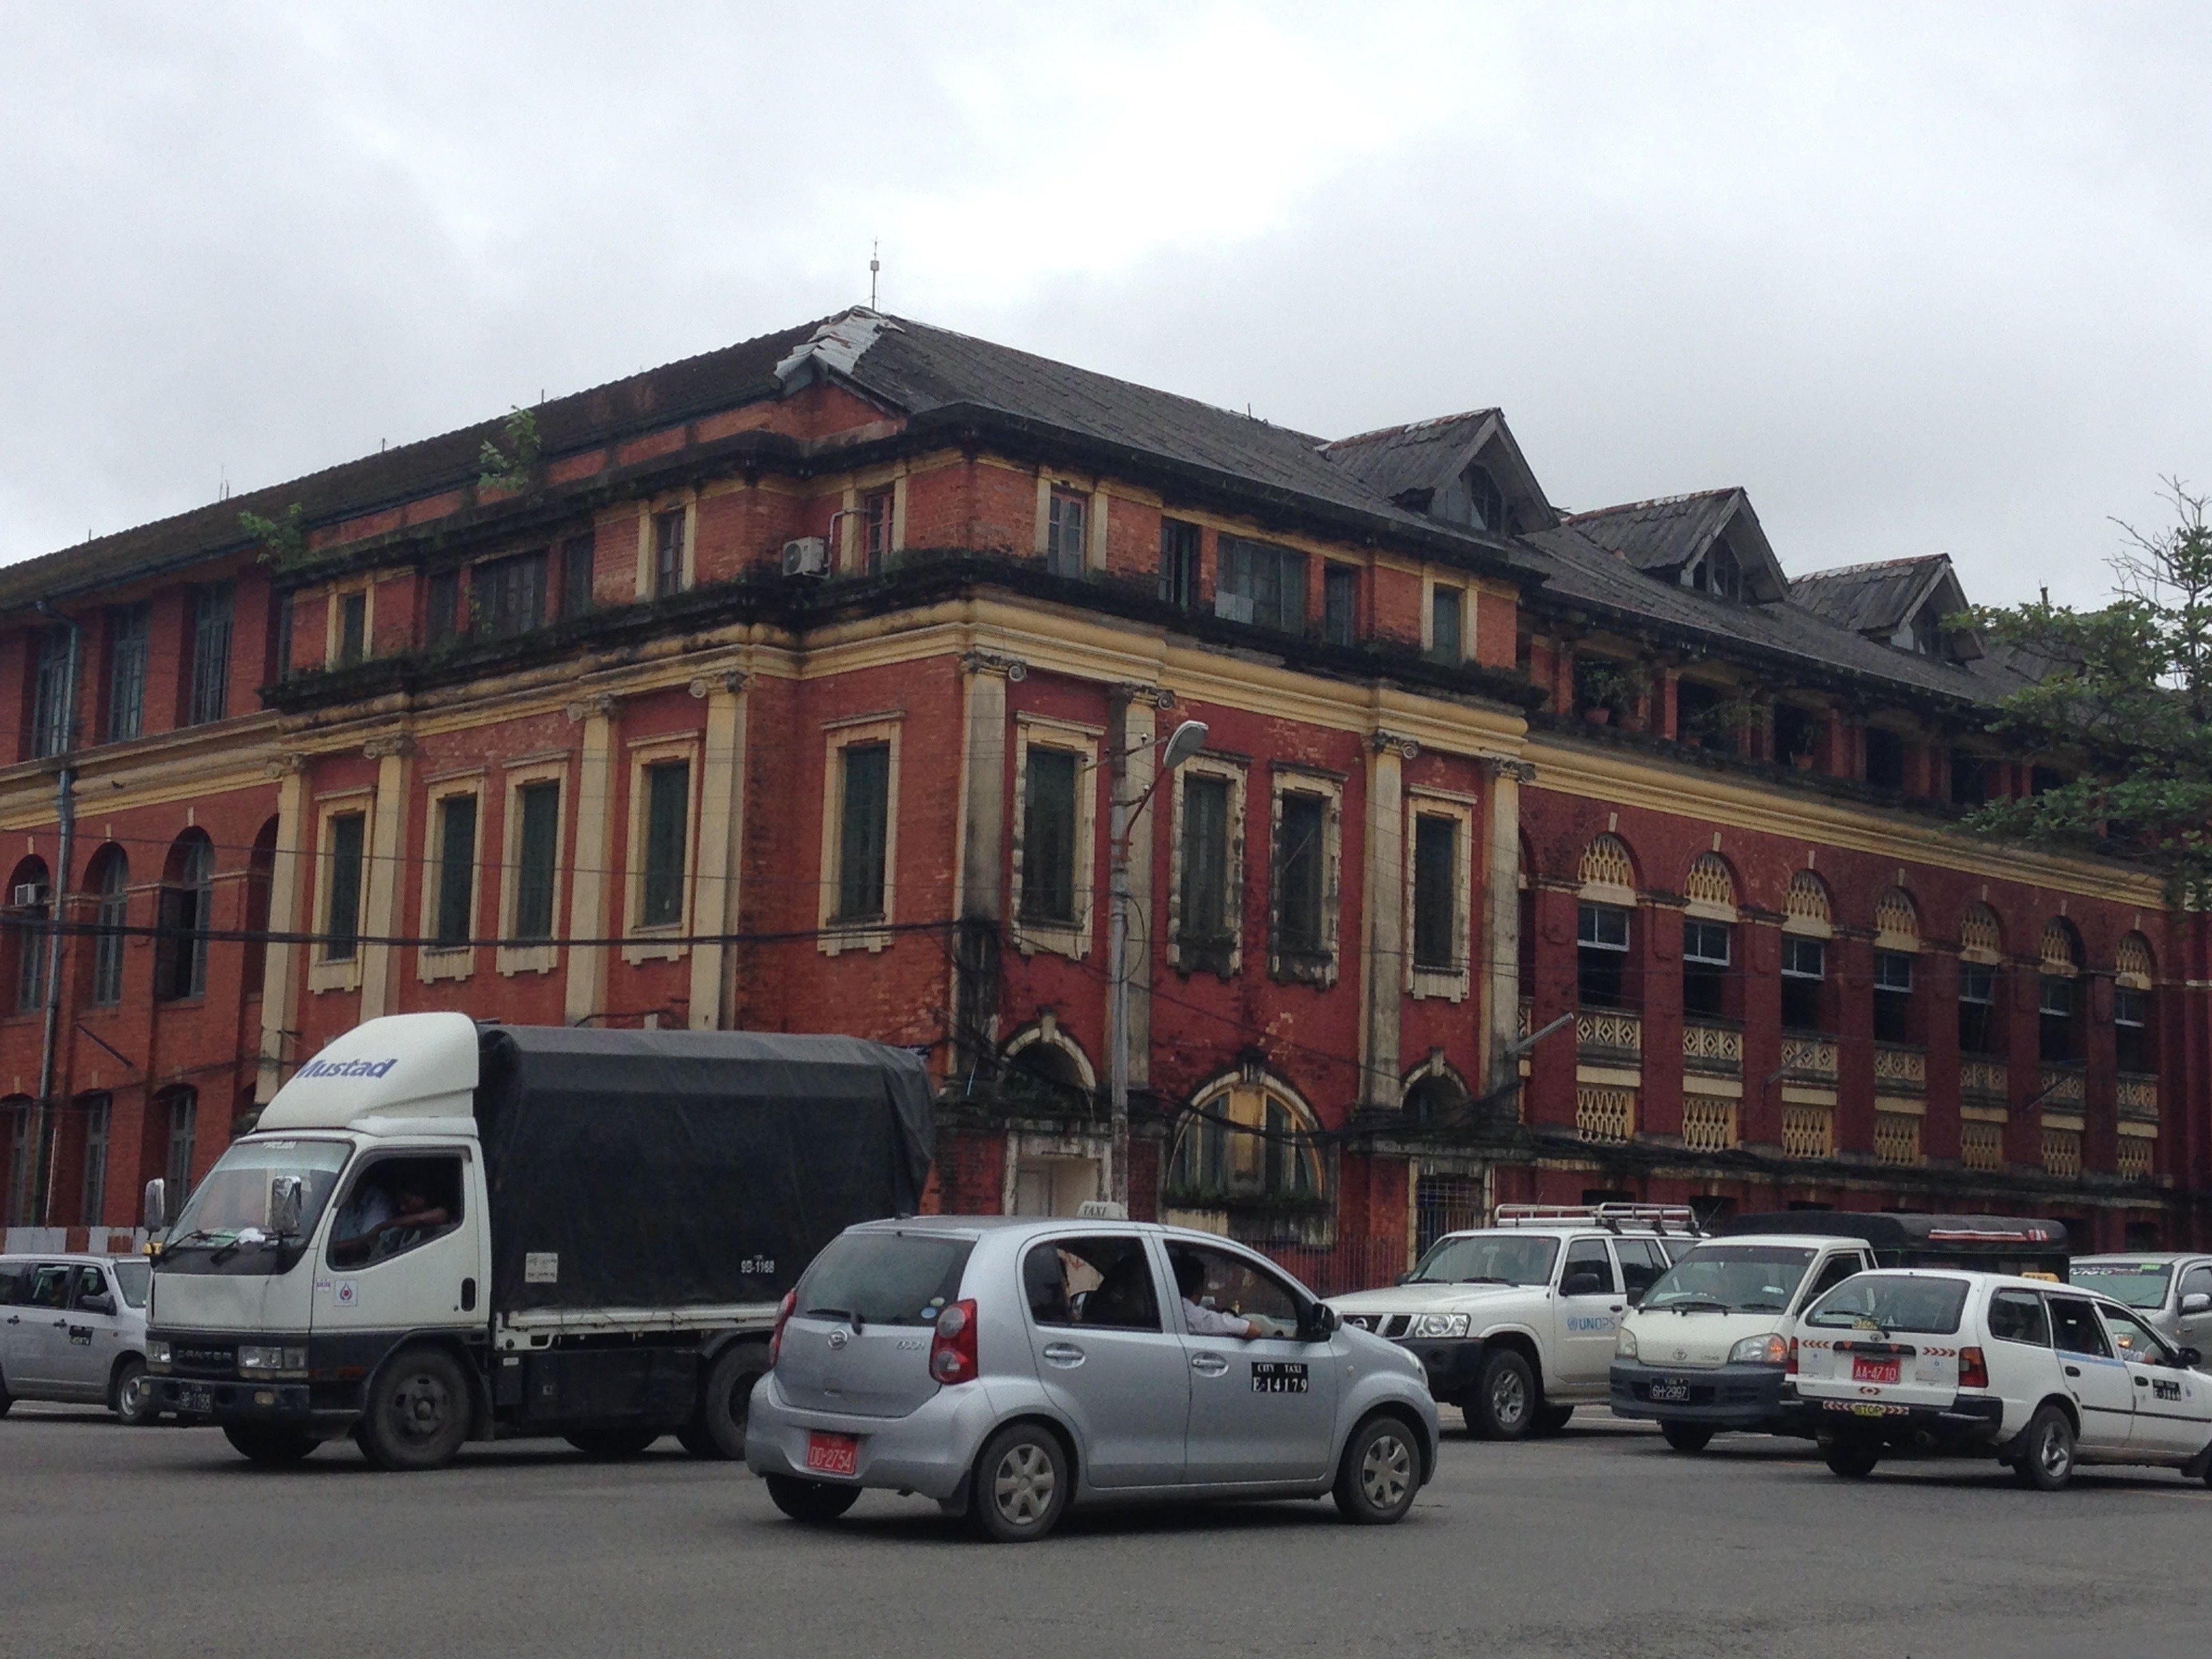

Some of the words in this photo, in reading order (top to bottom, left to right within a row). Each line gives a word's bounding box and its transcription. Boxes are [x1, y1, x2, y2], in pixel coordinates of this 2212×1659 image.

[295, 1059, 398, 1079] Mustad
[1084, 1206, 1106, 1215] TAXI
[1579, 1317, 1616, 1330] UNOPS
[1258, 1364, 1275, 1372] CITY
[1285, 1364, 1301, 1374] TAXI
[1855, 1366, 1897, 1380] AA-4710
[1253, 1376, 1307, 1392] E-14179
[1855, 1404, 1883, 1415] STOP
